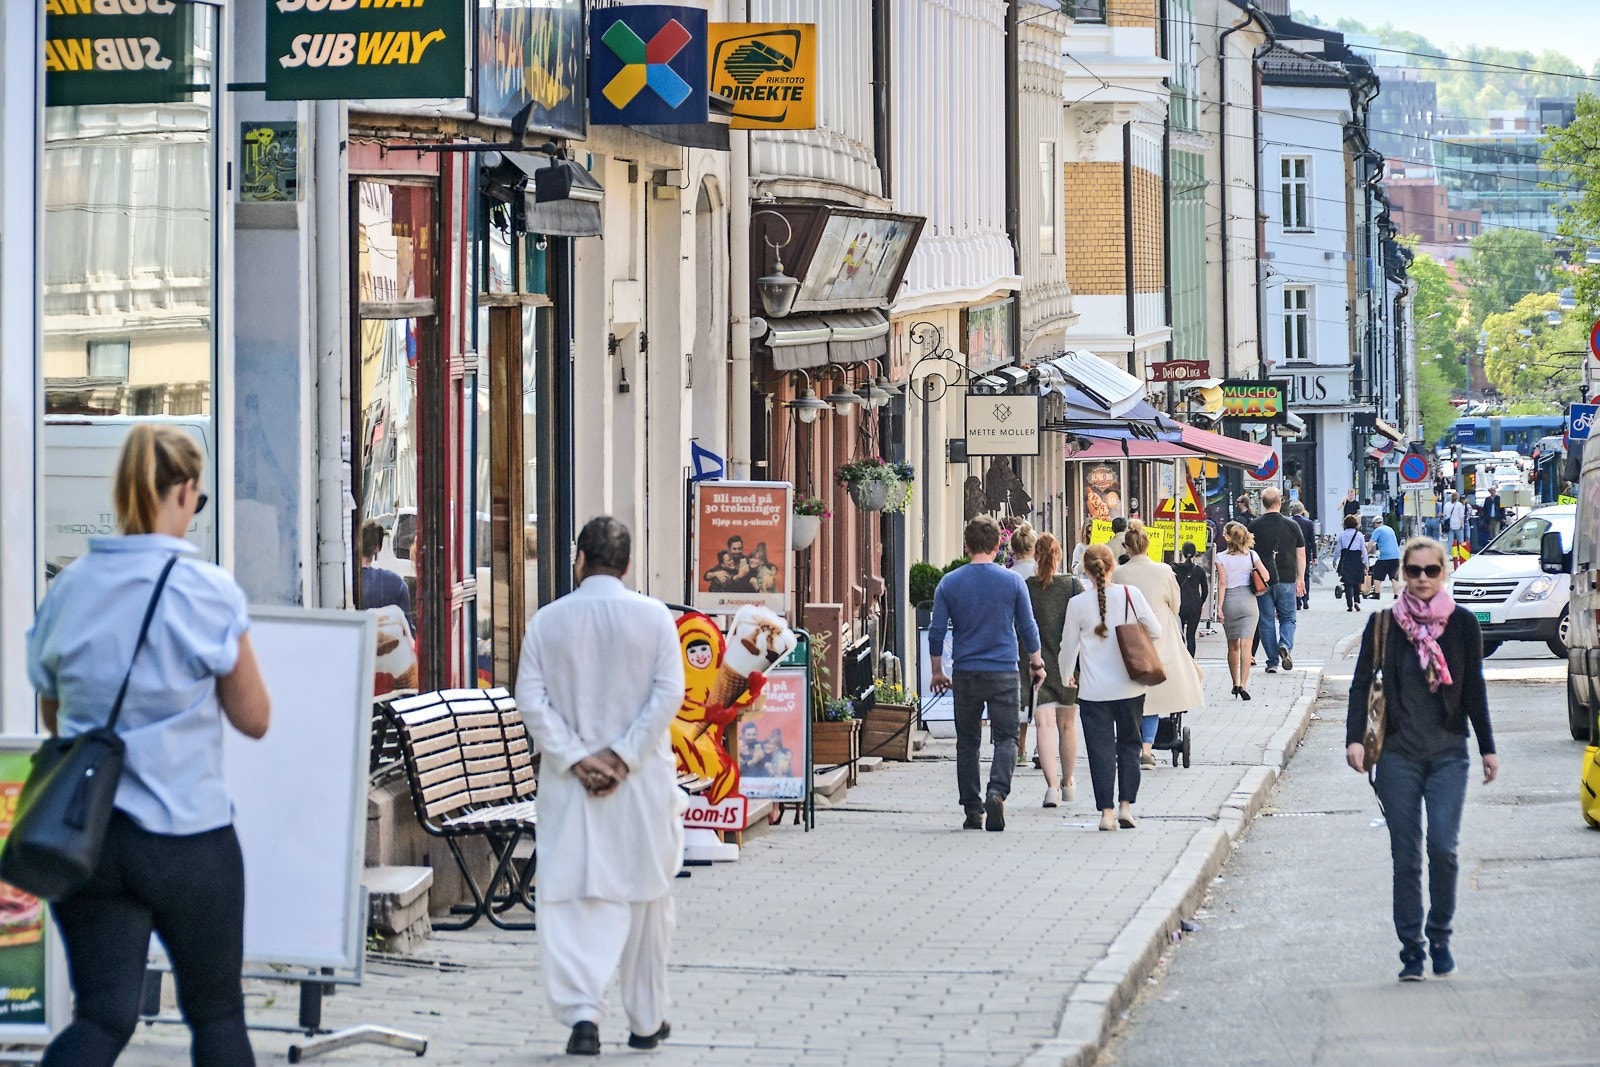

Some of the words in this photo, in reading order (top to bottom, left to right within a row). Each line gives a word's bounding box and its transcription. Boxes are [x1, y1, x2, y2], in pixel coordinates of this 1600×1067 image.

[278, 28, 446, 69] SUBWAY
[766, 76, 805, 84] RIKSTOTO
[720, 85, 804, 101] DIREKTE
[1162, 366, 1175, 379] Deli
[1186, 366, 1201, 378] Luca
[1223, 386, 1277, 398] MUCHO
[1223, 399, 1277, 417] MAS
[969, 428, 996, 436] METTE
[713, 493, 729, 503] Bli
[731, 493, 756, 503] med
[758, 493, 772, 506] på
[705, 505, 719, 514] 30
[720, 503, 781, 516] trekninger
[712, 518, 730, 528] Kjøp
[1184, 524, 1204, 533] benytt
[772, 680, 788, 692] på
[683, 806, 739, 824] LOM-IS
